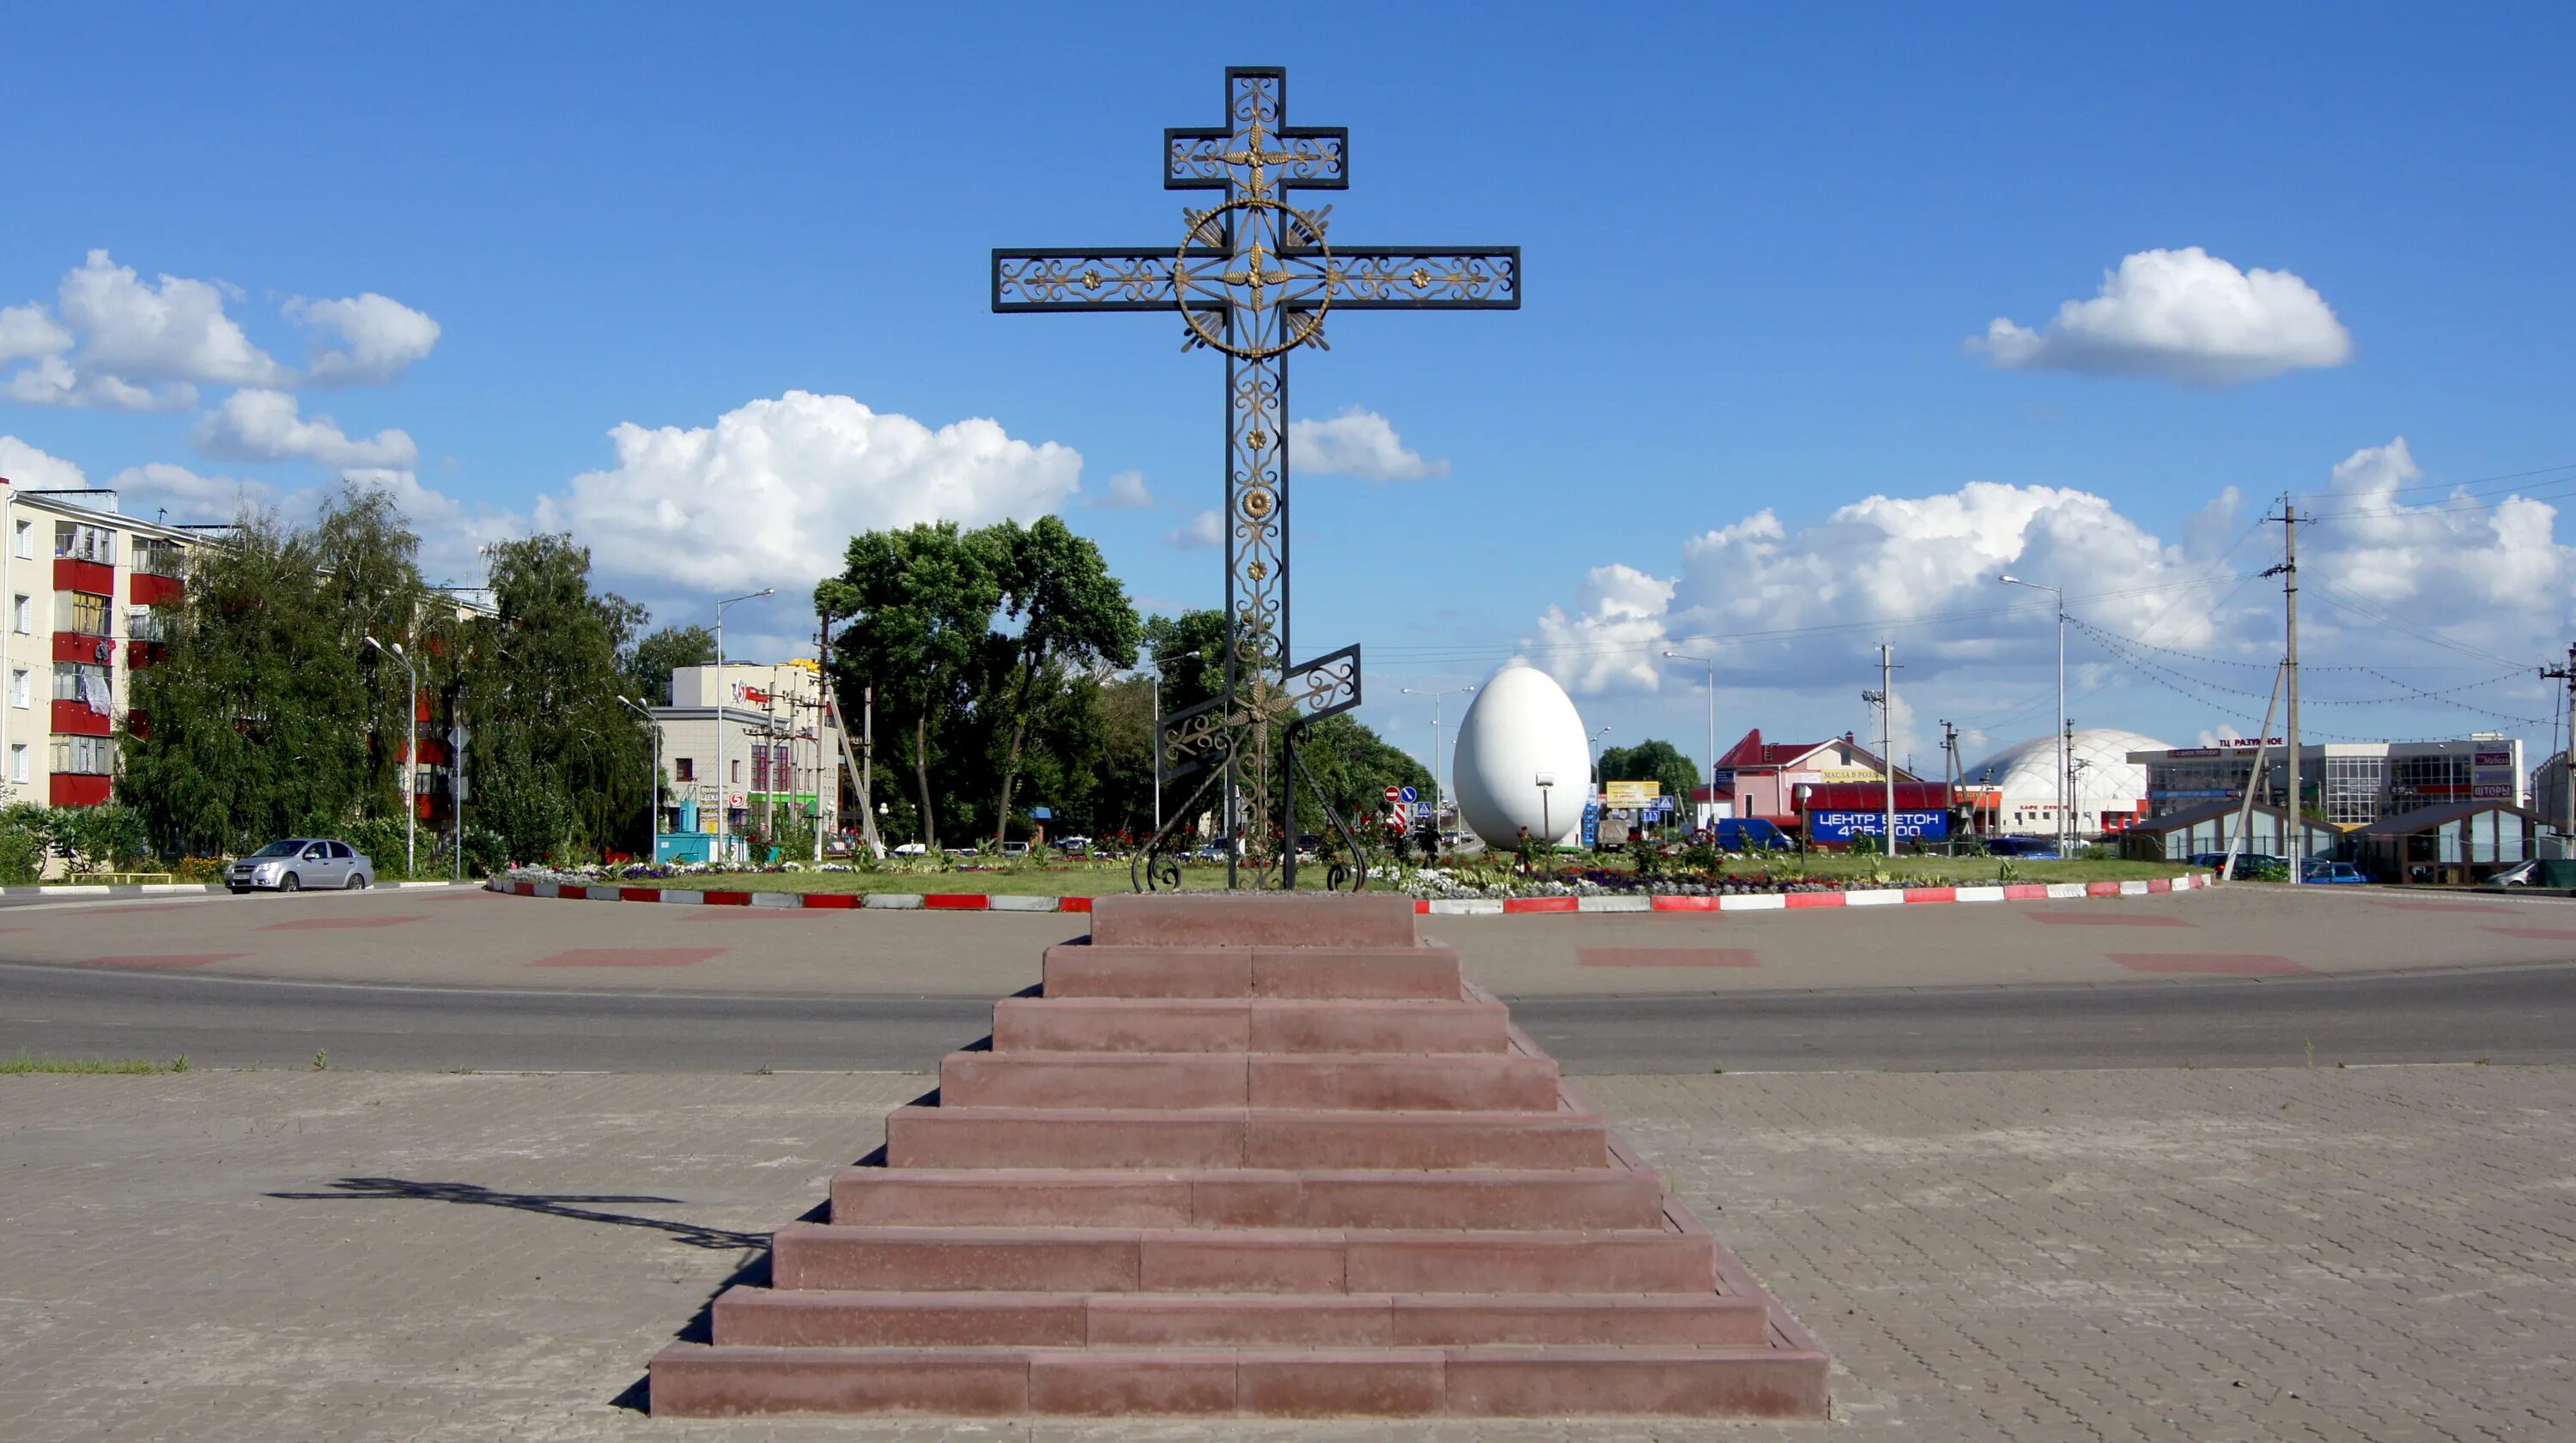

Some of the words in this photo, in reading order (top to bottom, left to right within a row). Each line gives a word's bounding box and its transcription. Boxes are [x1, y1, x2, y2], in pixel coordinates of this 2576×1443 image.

[2219, 739, 2230, 748] ТЦ
[2475, 786, 2510, 796] ШТОРЫ
[1820, 814, 1875, 826] ЦЕНТР
[1838, 826, 1920, 836] 425-00
